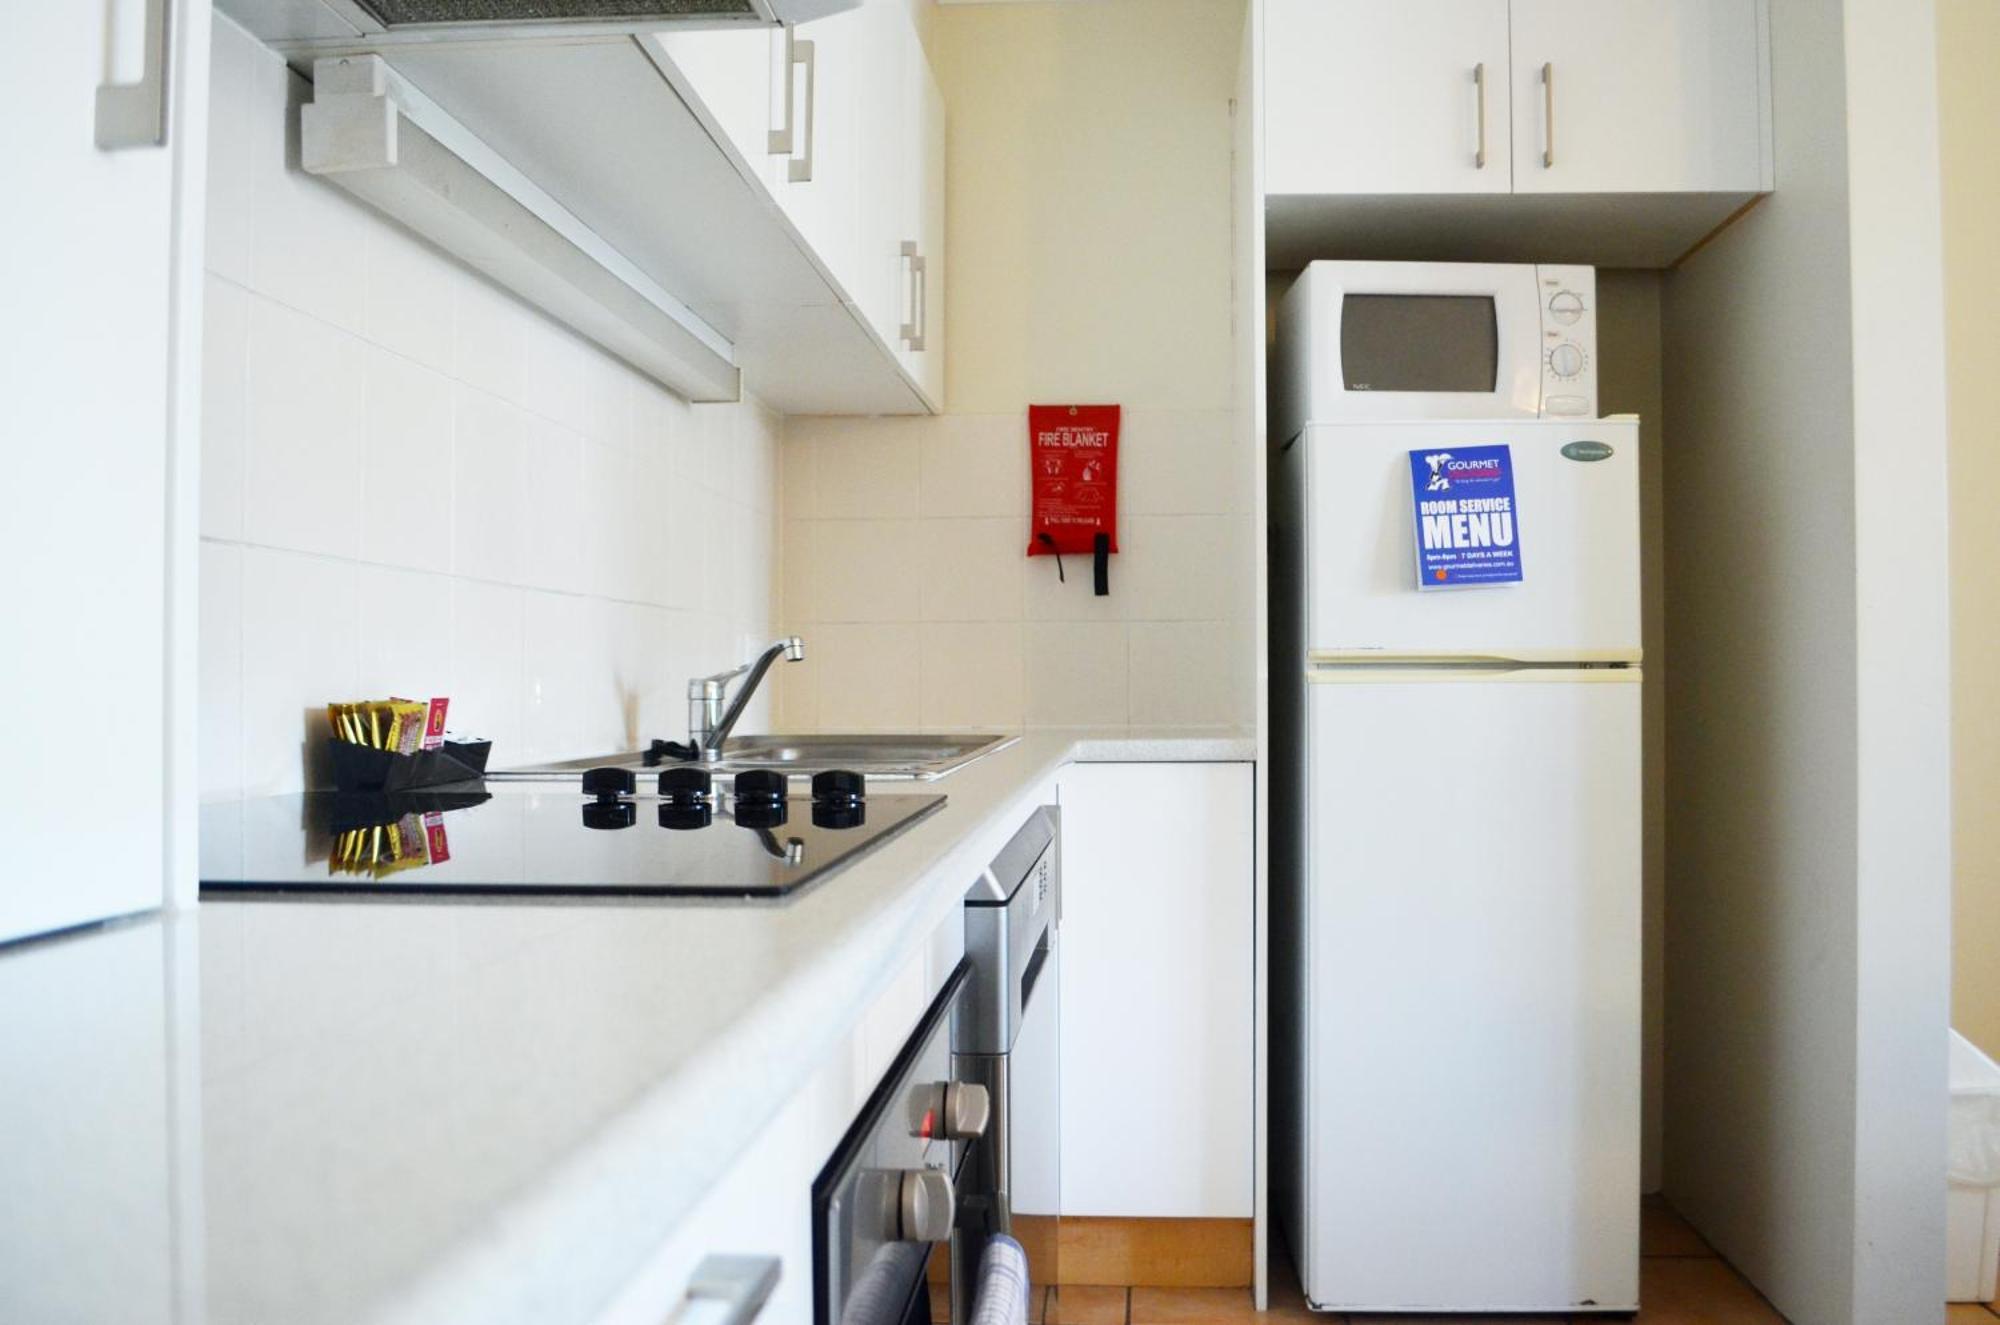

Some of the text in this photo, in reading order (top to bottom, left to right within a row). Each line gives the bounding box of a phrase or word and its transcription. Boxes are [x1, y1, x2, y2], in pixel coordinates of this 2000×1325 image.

[1038, 431, 1109, 447] FIRE BLANKET
[1447, 459, 1499, 470] GOURMET
[1420, 497, 1511, 515] ROOM SERVICE
[1422, 512, 1513, 550] MENU
[1466, 551, 1485, 559] DAYS
